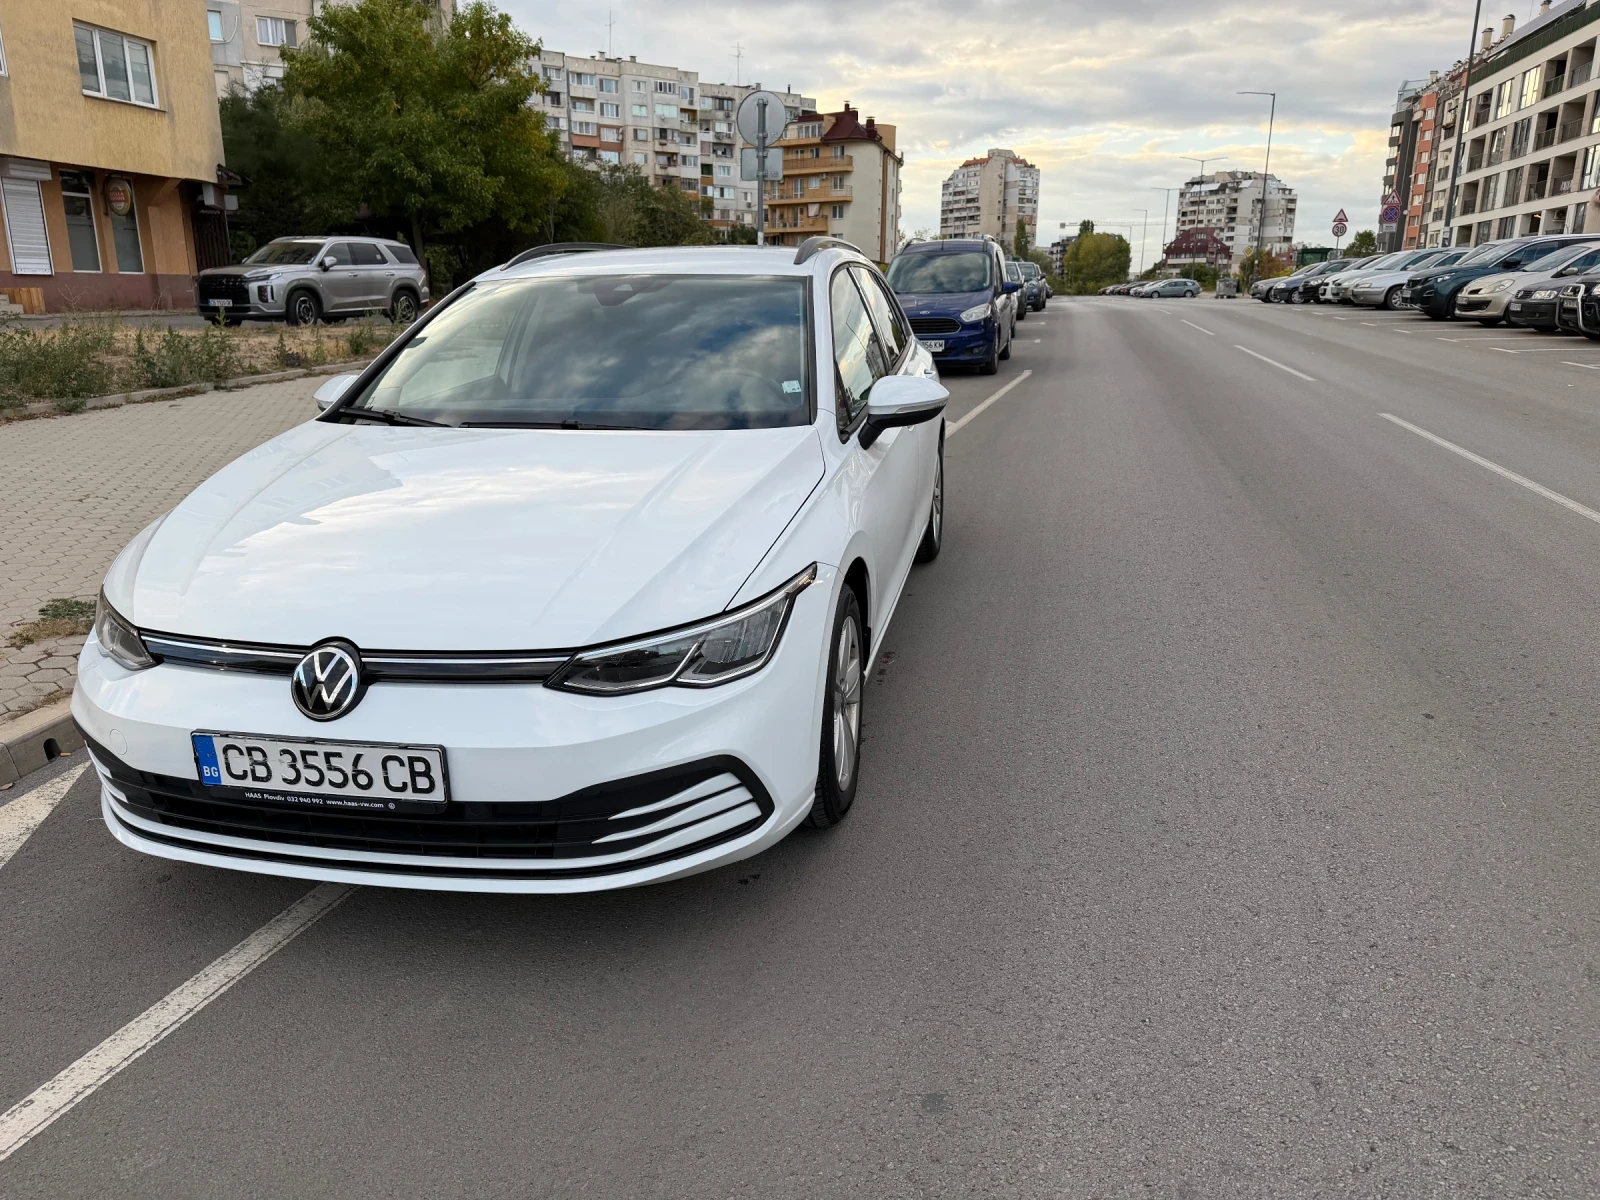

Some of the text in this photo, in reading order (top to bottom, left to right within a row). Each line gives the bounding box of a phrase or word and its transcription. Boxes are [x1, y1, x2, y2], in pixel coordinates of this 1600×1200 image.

[1335, 226, 1344, 234] 30
[296, 649, 355, 714] VW
[202, 765, 219, 778] BG
[222, 743, 436, 794] CB 3556 CB
[263, 793, 285, 801] Plovdiv
[299, 796, 311, 804] 940
[311, 797, 324, 805] 992
[325, 799, 385, 808] www.haas-vw.com
